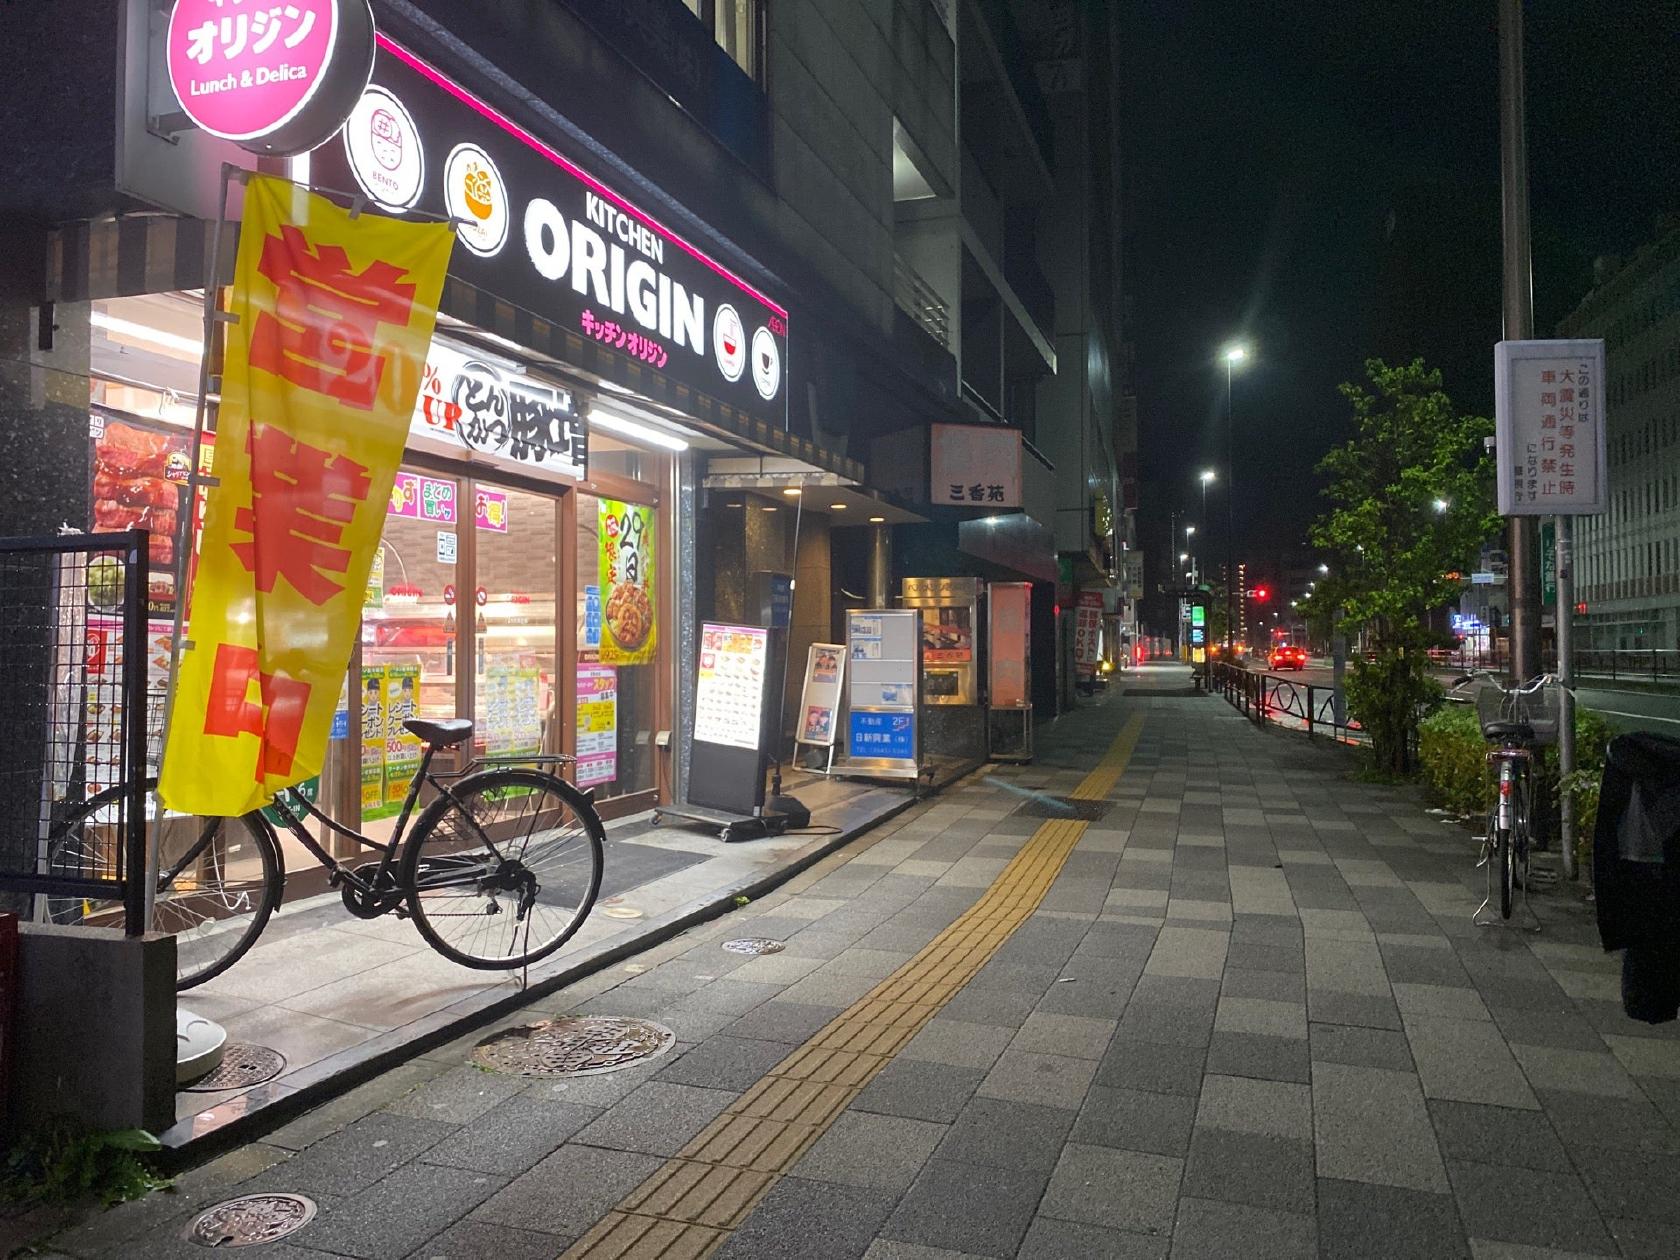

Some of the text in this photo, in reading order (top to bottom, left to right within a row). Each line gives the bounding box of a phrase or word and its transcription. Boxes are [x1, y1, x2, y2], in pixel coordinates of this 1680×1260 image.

[186, 5, 316, 64] オリジン
[191, 64, 307, 96] Lunch & Delica
[372, 170, 399, 191] BENTO
[586, 191, 663, 264] KITCHEN
[523, 198, 704, 356] ORIGIN
[581, 309, 668, 369] キッチンオリジン
[423, 395, 462, 431] UP
[1578, 363, 1590, 423] この通りは
[1540, 370, 1557, 495] 車両通行禁止
[949, 483, 1005, 502] 三香苑
[388, 700, 416, 714] レシート
